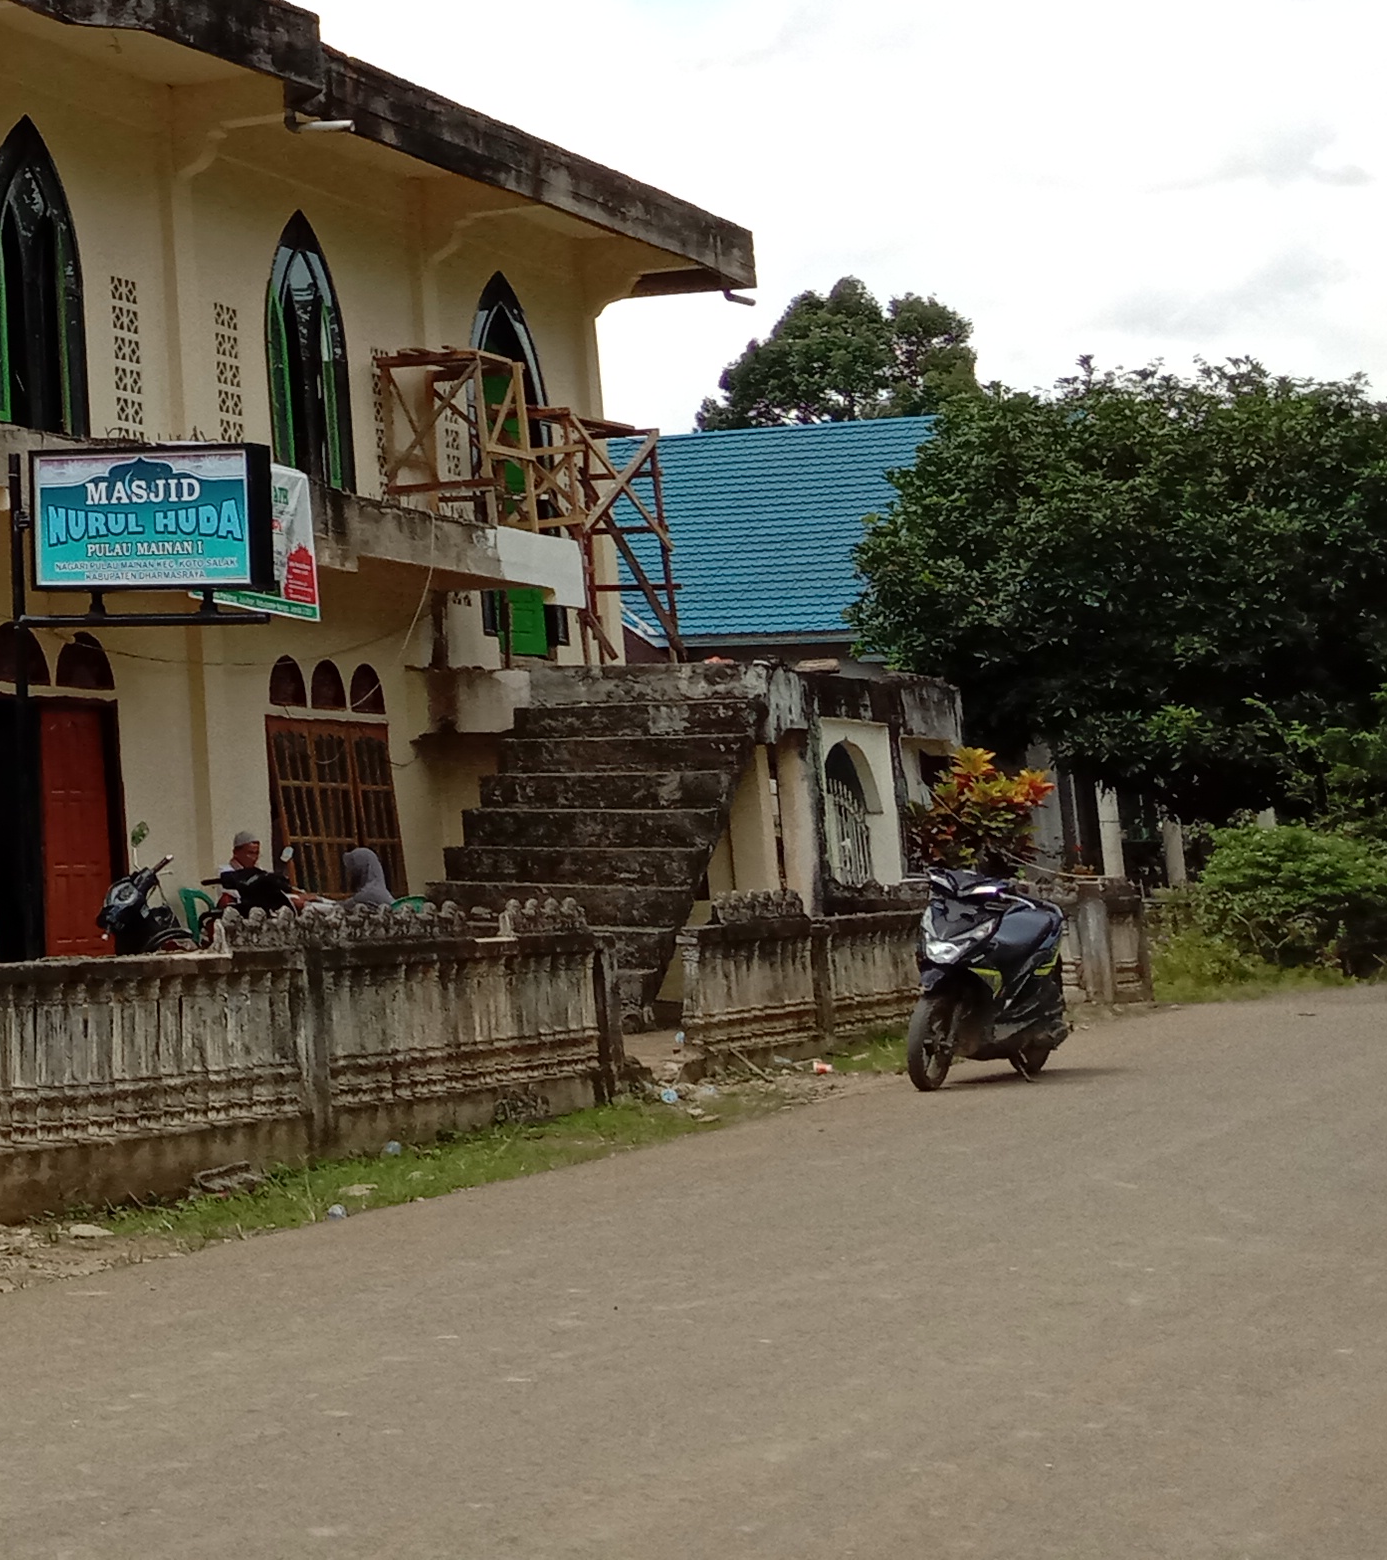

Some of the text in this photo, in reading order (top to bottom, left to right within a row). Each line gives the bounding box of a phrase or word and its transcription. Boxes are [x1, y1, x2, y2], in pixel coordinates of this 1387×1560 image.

[84, 478, 201, 505] MASJID
[47, 498, 244, 547] NURUL HUDA
[86, 540, 204, 557] PULAU MAINAN I
[55, 561, 88, 572] NAGARI
[89, 561, 119, 571] PULAU
[120, 560, 155, 570] MAINAN
[179, 559, 205, 569] KOTO
[206, 558, 237, 568] SALAK
[85, 569, 207, 582] KABUPATEN DHARMASRAYA
